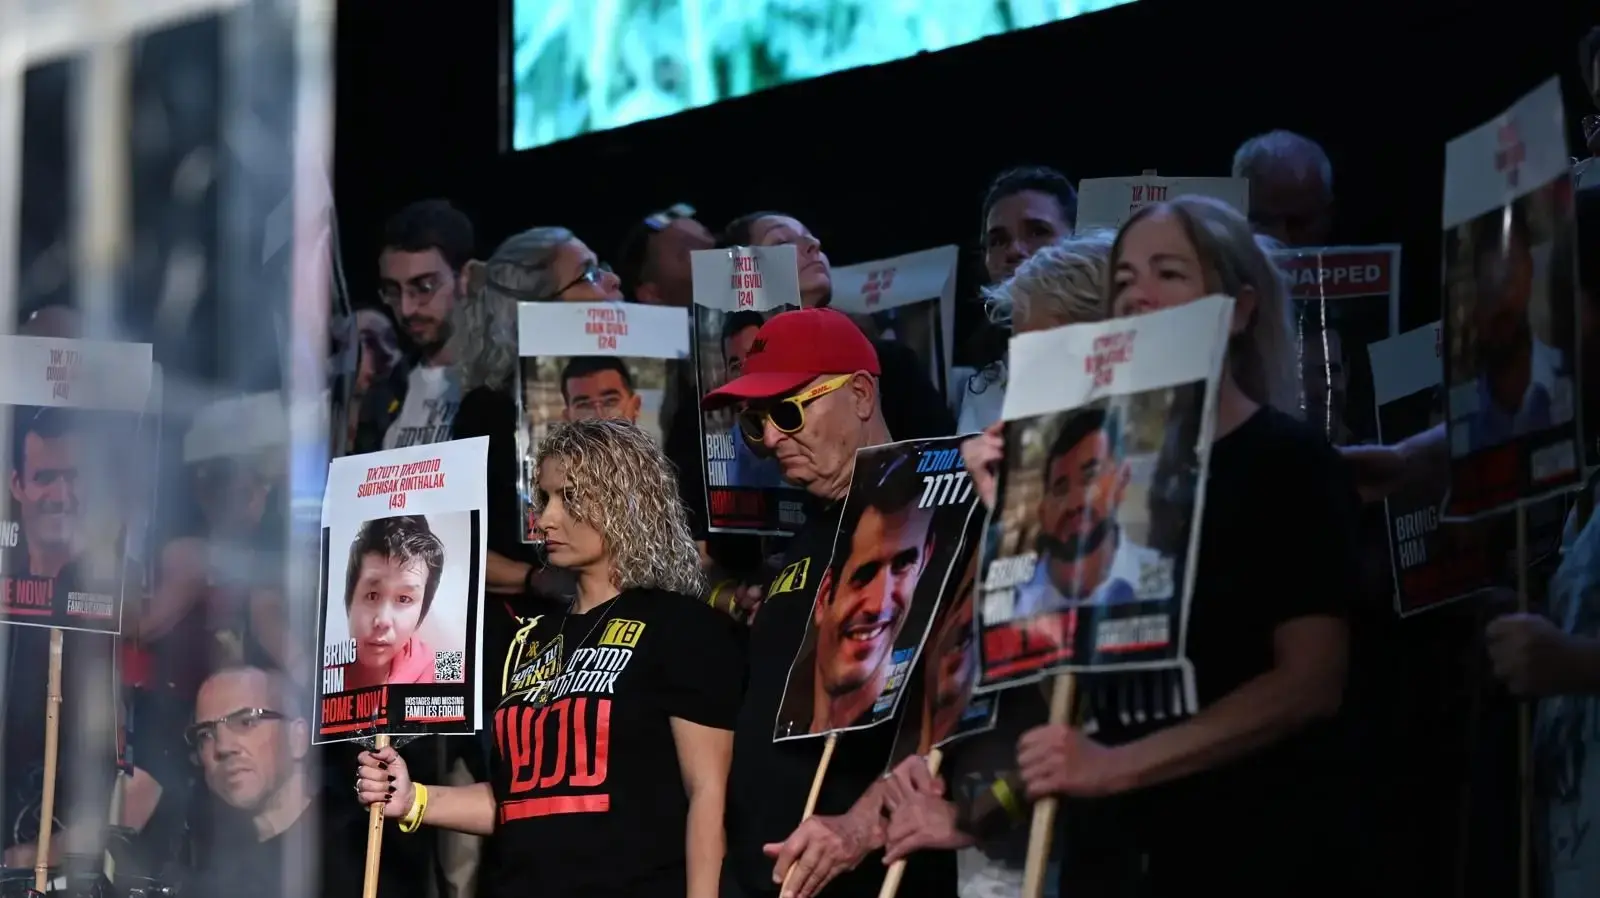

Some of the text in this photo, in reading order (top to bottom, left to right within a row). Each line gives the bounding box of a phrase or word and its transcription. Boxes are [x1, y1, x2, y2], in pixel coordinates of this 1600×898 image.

[744, 273, 763, 288] GVILI
[1283, 263, 1381, 286] NAPPED
[705, 434, 735, 459] BRING
[357, 473, 445, 498] SUDTHISAK RINTHALAK
[708, 461, 728, 486] HIM
[389, 492, 406, 510] (43)
[1396, 506, 1437, 541] BRING
[323, 637, 357, 667] BRING
[322, 667, 344, 694] HIM
[570, 670, 622, 694] אותם
[321, 686, 388, 723] HOME NOW!
[405, 696, 464, 705] HOSTAGES AND MISSING
[405, 706, 464, 718] FAMILIES FORUM
[495, 697, 612, 793] עכשי
